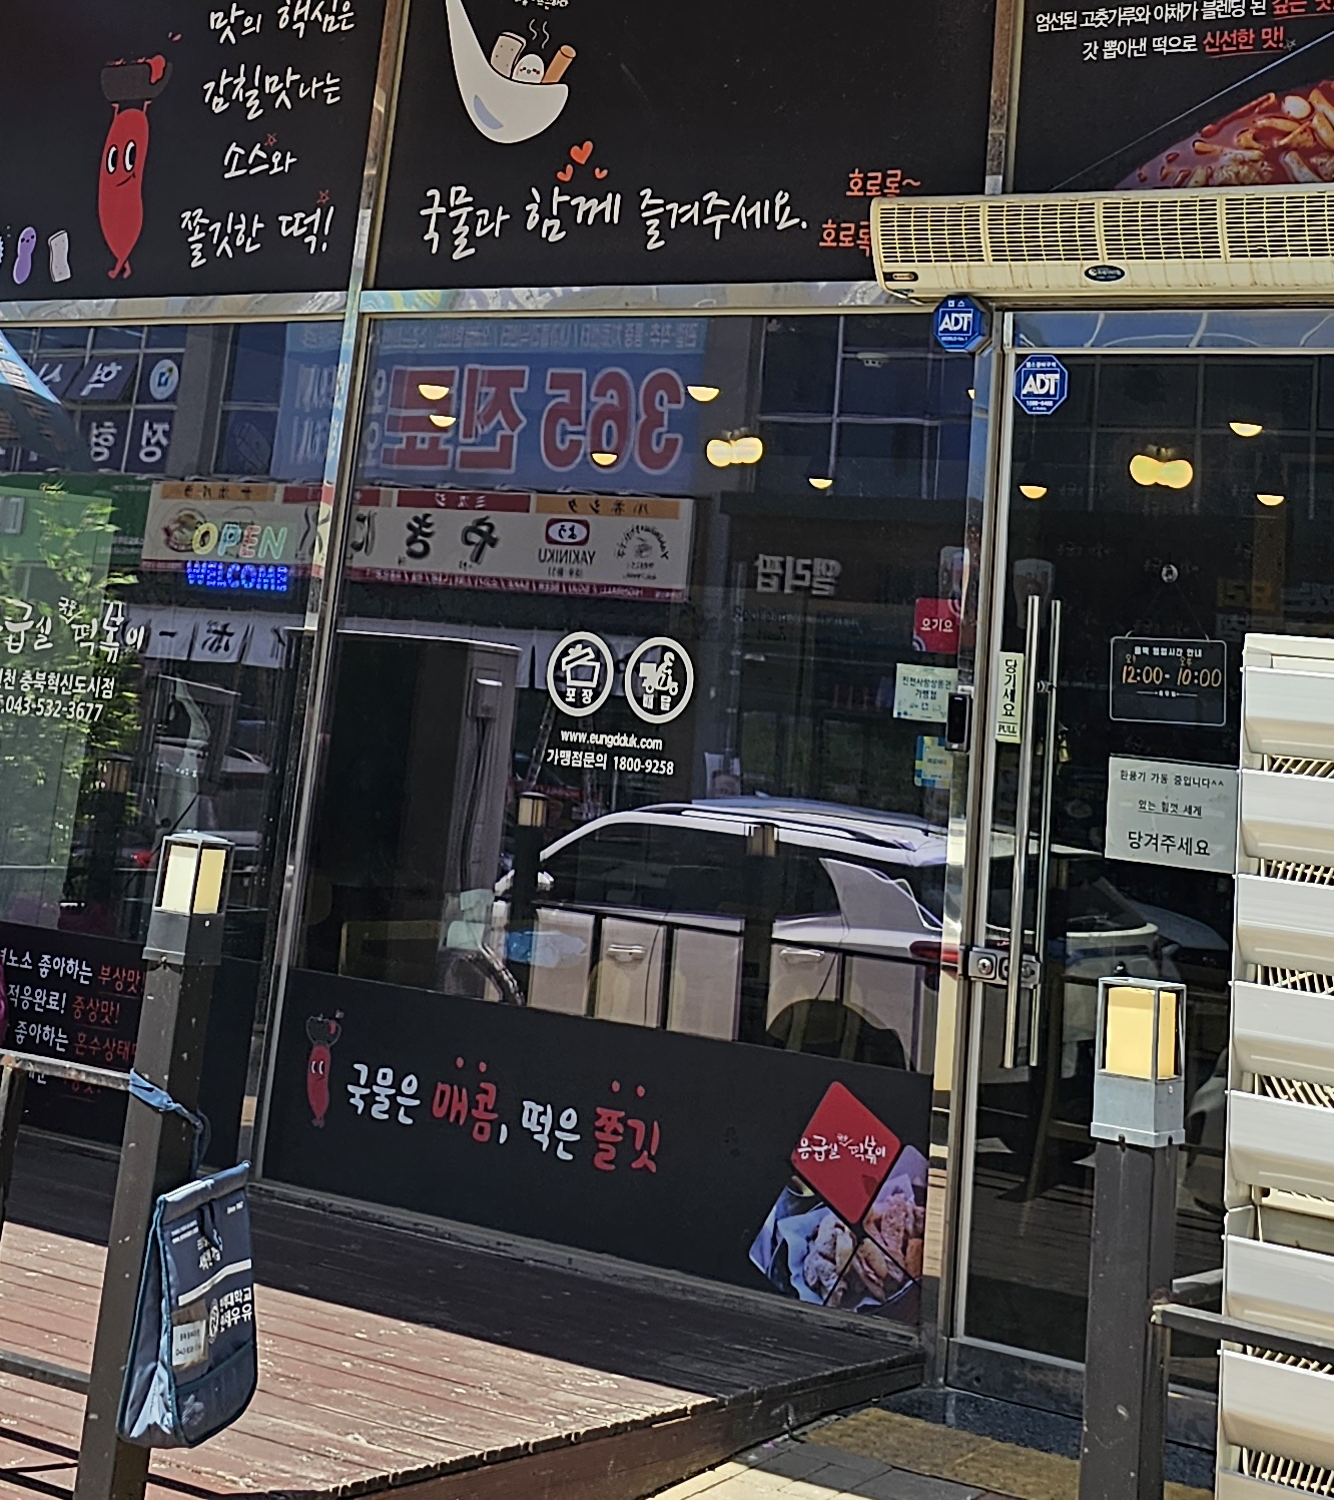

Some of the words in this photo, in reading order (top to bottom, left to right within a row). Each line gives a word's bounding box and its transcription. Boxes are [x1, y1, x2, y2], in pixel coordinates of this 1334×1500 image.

[208, 1, 262, 45] 맛의
[1035, 10, 1078, 33] 엄선된
[1079, 5, 1151, 30] 고춧가루와
[1082, 40, 1100, 63] 갓
[1101, 36, 1148, 60] 뽑아낸
[1151, 33, 1199, 56] 떡으로
[1202, 28, 1256, 53] 신선한
[1260, 25, 1285, 49] 맛!
[202, 63, 342, 121] 감칠맛나는
[222, 141, 298, 181] 소스와
[180, 205, 266, 269] 쫄깃한
[278, 204, 336, 252] 떡!
[419, 185, 512, 261] 국물과
[525, 185, 622, 243] 함께
[638, 187, 809, 251] 즐겨주세요.
[938, 312, 973, 332] ADT
[1021, 373, 1061, 395] ADT
[191, 519, 288, 562] OPEN
[183, 559, 289, 593] WELCOME
[70, 599, 145, 664] 떡볶이
[920, 617, 954, 633] 요기요
[19, 670, 116, 700] 충북혁신도시점
[1001, 658, 1018, 718] 당기세요
[1176, 666, 1222, 688] 10:00
[565, 687, 594, 705] 포장
[560, 729, 663, 751] www.eungdduk.com
[997, 723, 1018, 735] PULL
[546, 748, 608, 771] 가맹점문의
[613, 756, 675, 776] 1800-9258
[1127, 830, 1211, 857] 당겨주세요
[37, 953, 94, 986] 좋아하는
[6, 983, 67, 1015] 적응완료!
[71, 995, 120, 1026] 중상맛!
[14, 1020, 69, 1053] 좋아하는
[345, 1062, 421, 1125] 국물은
[431, 1078, 508, 1146] 매콤,
[521, 1098, 583, 1162] 떡은
[592, 1104, 661, 1175] 쫄깃
[797, 1134, 841, 1162] 응급실
[847, 1134, 887, 1165] 떡볶이
